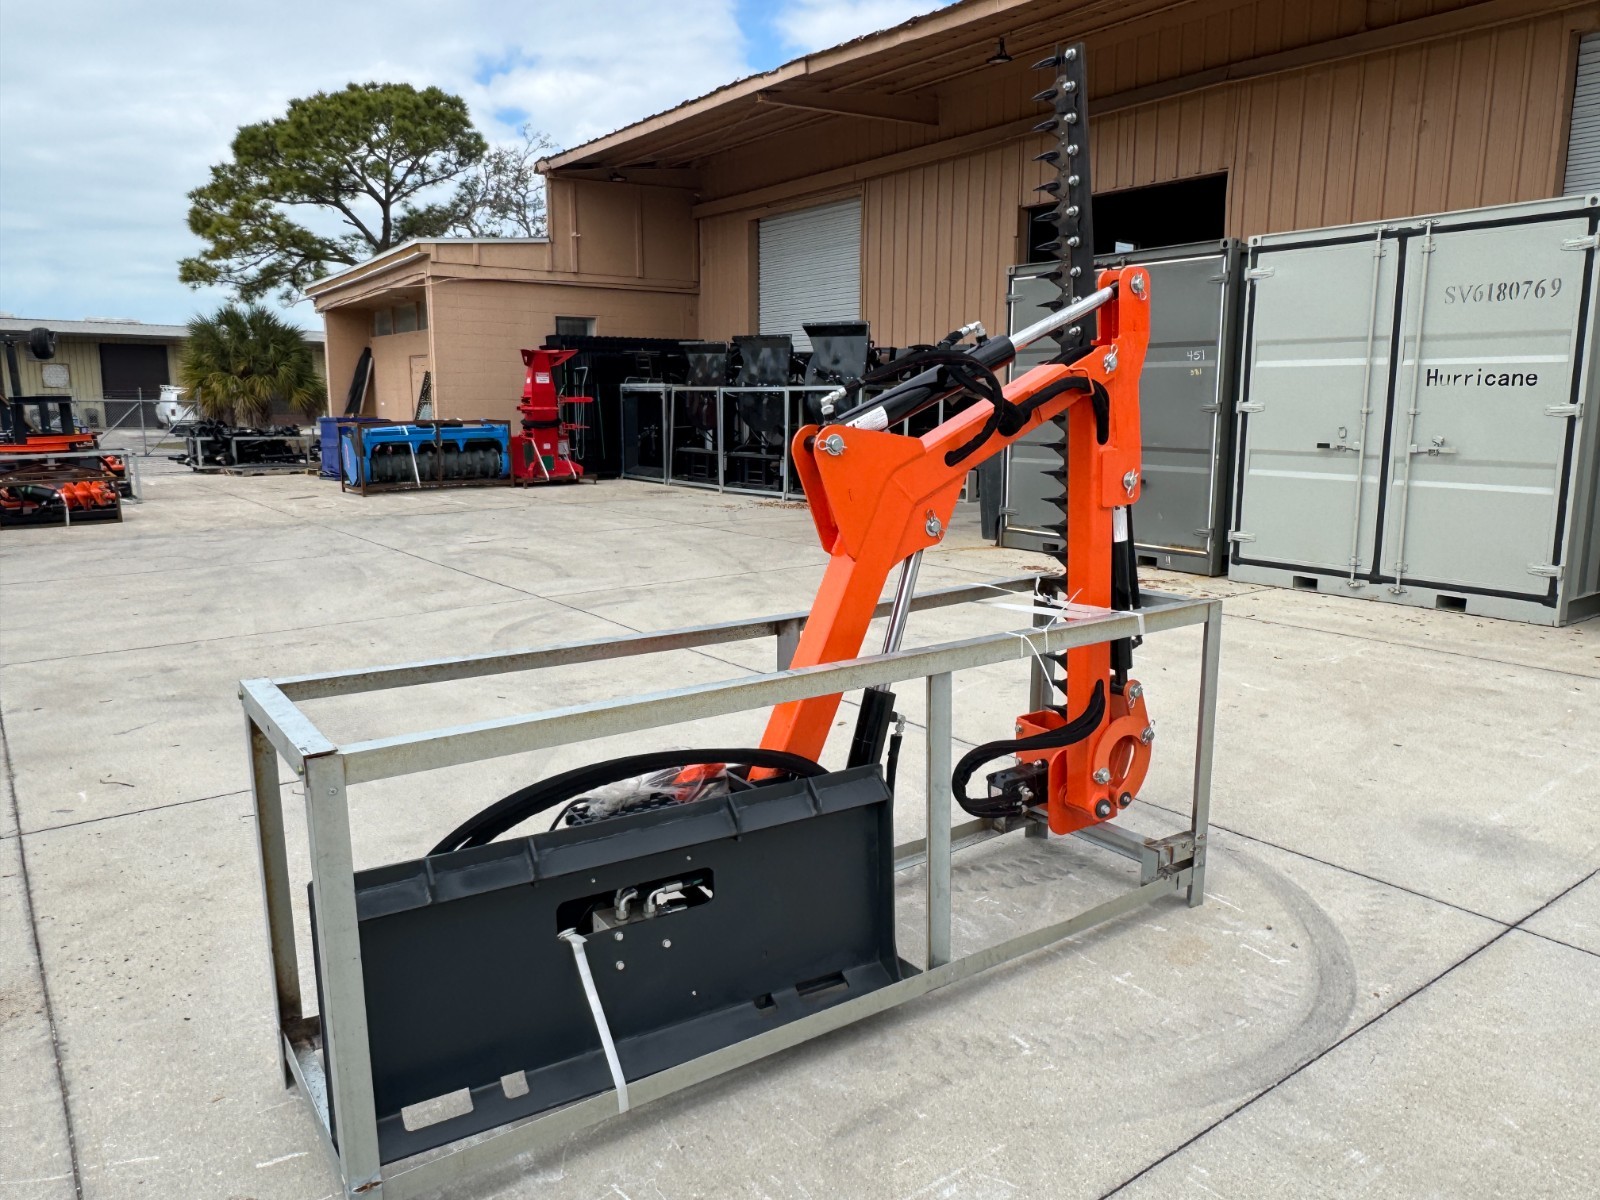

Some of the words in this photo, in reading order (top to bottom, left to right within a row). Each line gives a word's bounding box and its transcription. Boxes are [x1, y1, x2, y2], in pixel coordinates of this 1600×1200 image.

[1444, 278, 1562, 304] SV6180769
[1186, 350, 1205, 361] 451
[1426, 368, 1538, 387] Hurricane
